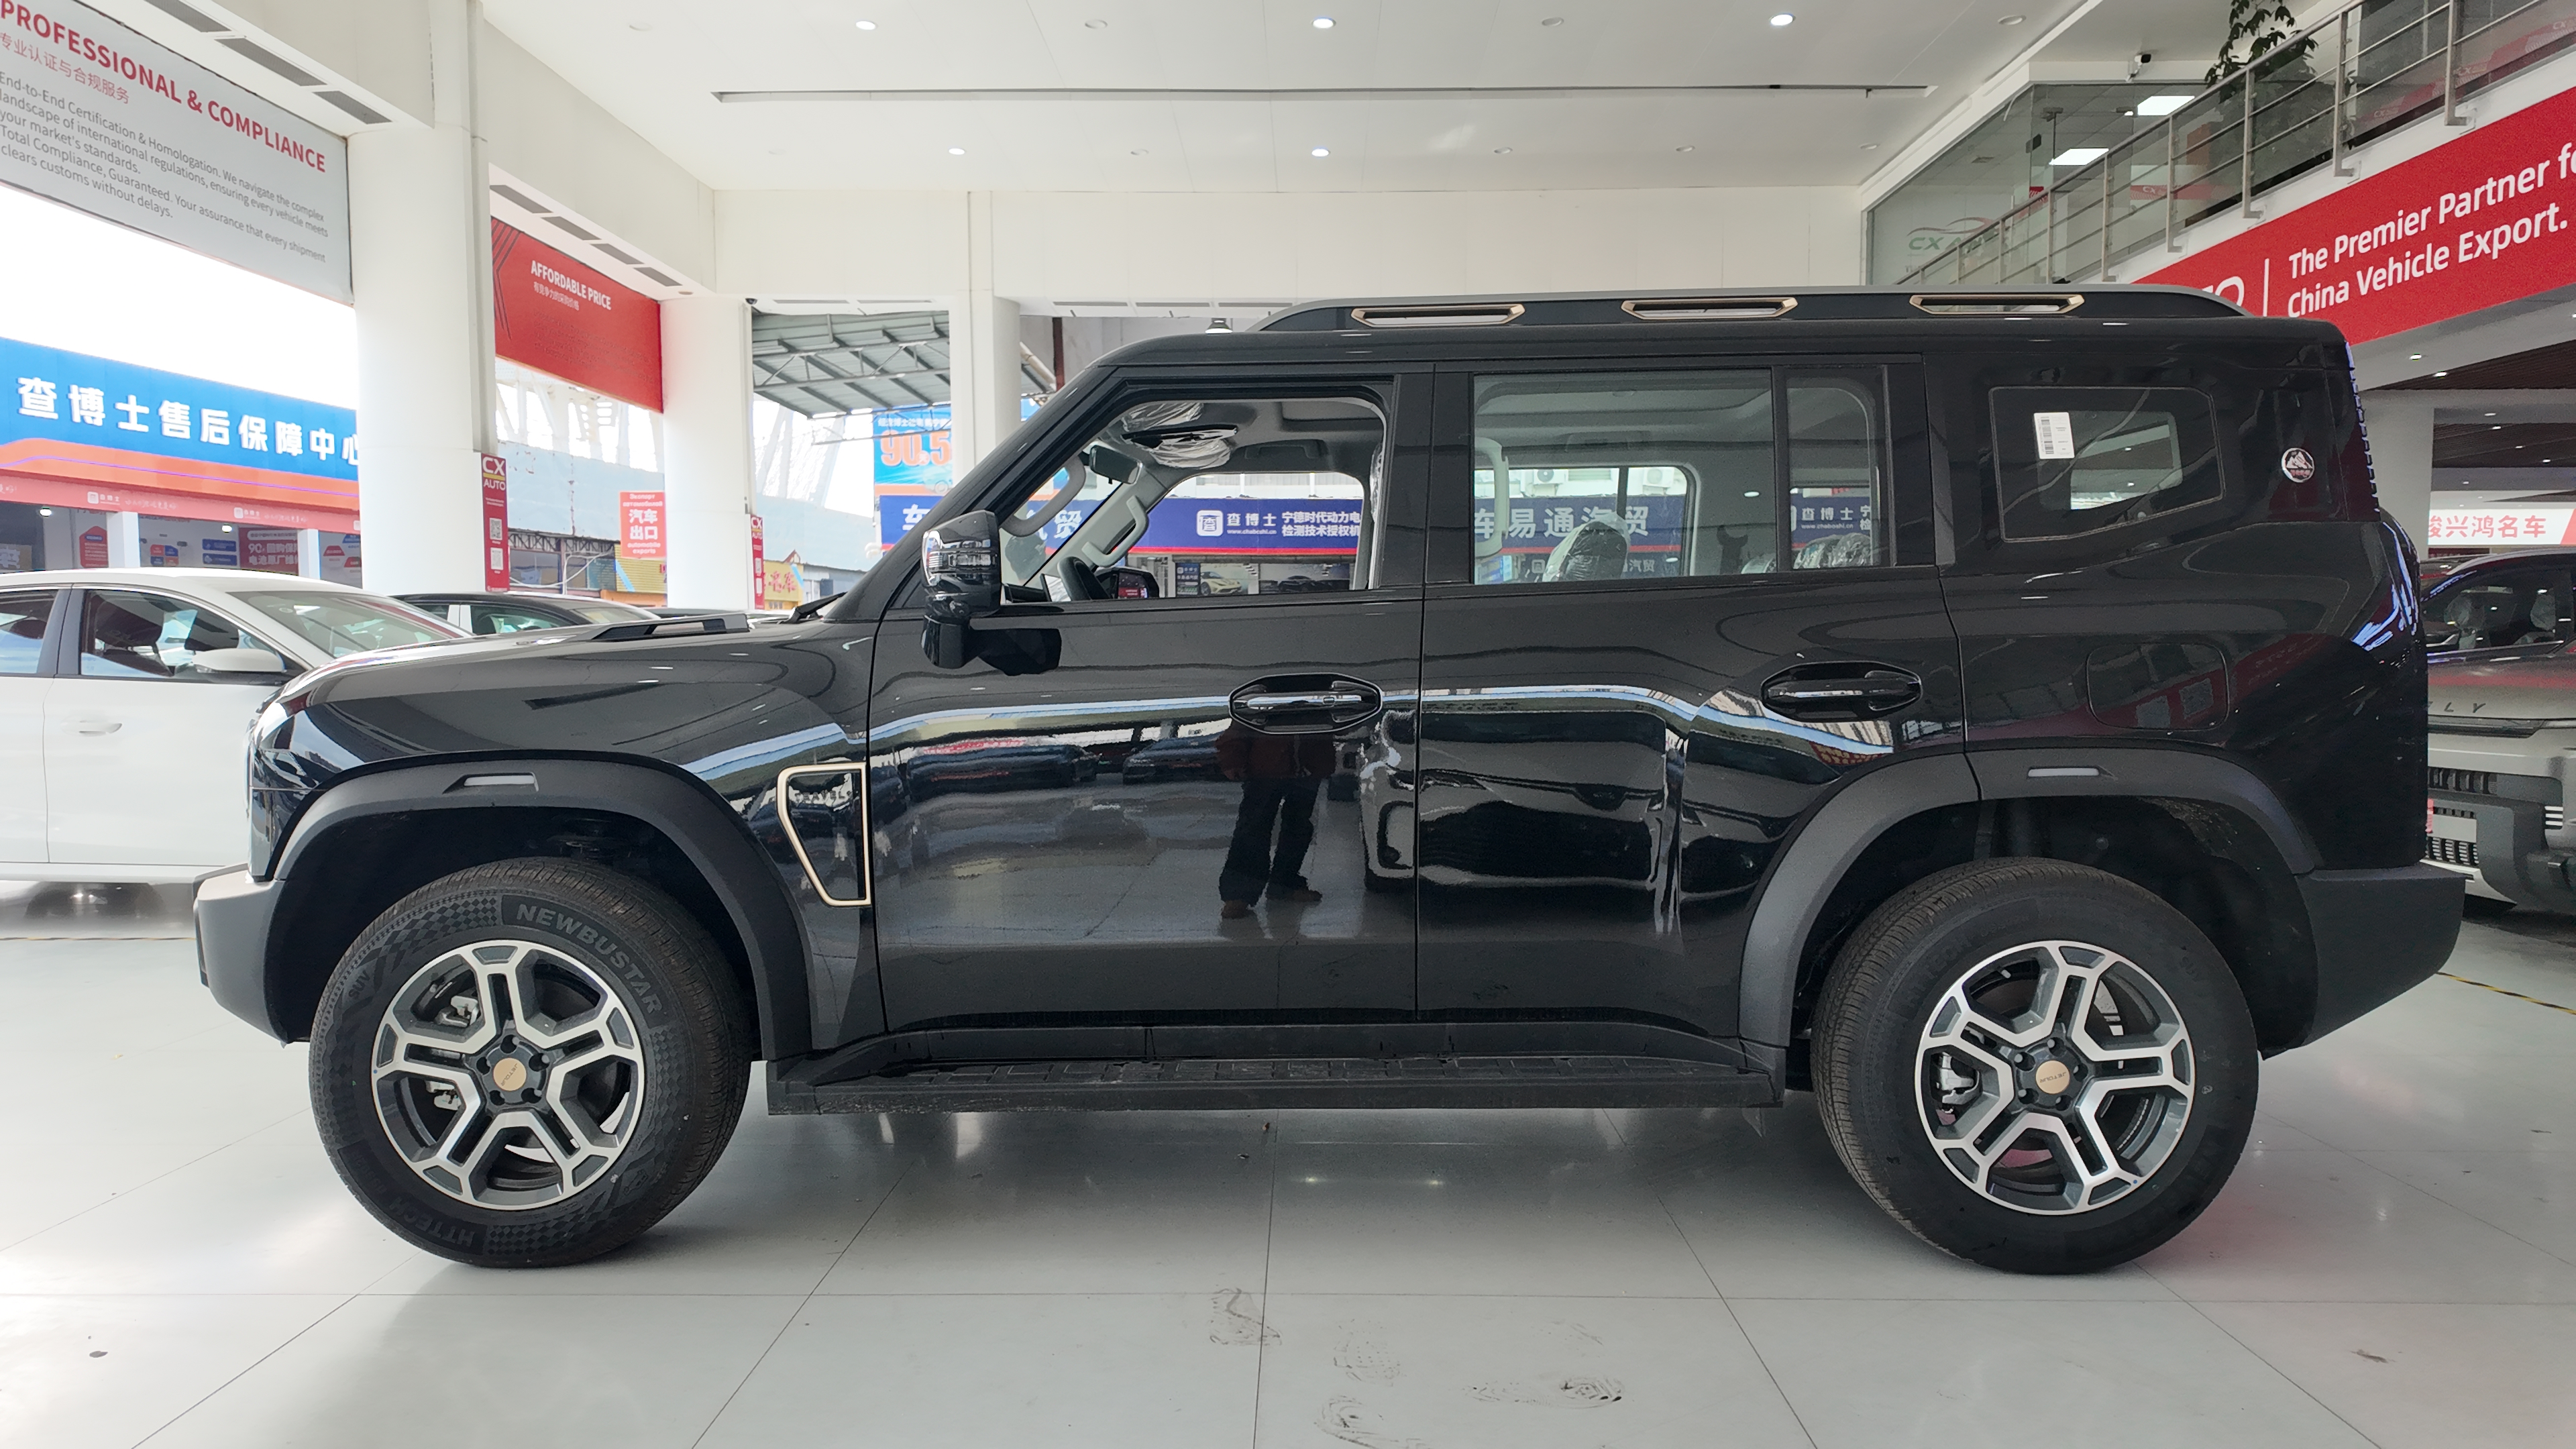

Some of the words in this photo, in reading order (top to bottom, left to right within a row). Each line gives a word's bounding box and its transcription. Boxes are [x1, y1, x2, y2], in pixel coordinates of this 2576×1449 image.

[0, 32, 129, 105] 专业认证与合规服务
[1, 0, 182, 104] PROFESSIONAL
[187, 89, 203, 113] &
[208, 101, 325, 172] COMPLIANCE
[0, 109, 26, 127] your
[30, 121, 81, 150] market's
[83, 143, 142, 175] standards.
[0, 70, 65, 109] End-to-End
[68, 101, 136, 140] Certification
[139, 132, 146, 145] &
[148, 136, 222, 178] Homologation.
[222, 169, 237, 185] We
[239, 179, 274, 201] navigate
[276, 194, 290, 207] the
[291, 203, 324, 222] complex
[0, 88, 60, 125] landscape
[62, 117, 74, 129] of
[76, 121, 148, 162] international
[150, 155, 209, 189] regulations,
[210, 180, 250, 207] ensuring
[250, 197, 274, 217] every
[275, 209, 303, 227] vehicle
[305, 221, 329, 238] meets
[1, 144, 38, 166] clears
[40, 159, 89, 186] customs
[91, 179, 136, 204] without
[137, 195, 174, 219] delays.
[1, 123, 30, 147] Total
[33, 137, 107, 178] Compliance,
[108, 168, 173, 203] Guaranteed.
[174, 193, 197, 213] Your
[199, 205, 244, 231] assurance
[246, 223, 264, 239] that
[265, 233, 288, 250] every
[289, 240, 326, 264] shipment
[1908, 236, 1944, 251] CX
[2288, 244, 2328, 279] The
[2334, 206, 2432, 264] Premier
[2438, 160, 2551, 224] Partner
[531, 260, 587, 299] AFFORDABLE
[588, 286, 612, 311] PRICE
[2287, 280, 2349, 319] China
[2356, 244, 2451, 297] Vehicle
[2457, 202, 2569, 264] Export.
[17, 376, 358, 466] 查博士售后保障中心
[482, 456, 505, 476] CX
[483, 478, 506, 491] AUTO
[629, 508, 658, 524] 汽车
[629, 525, 658, 541] 出口
[751, 517, 763, 529] CX
[1226, 513, 1277, 527] 查博士
[1801, 507, 1854, 521] 查博士
[348, 970, 370, 998] SUV
[516, 904, 663, 1014] NEWBUSTAR
[500, 1063, 518, 1086] JETOUR
[2039, 1072, 2066, 1083] JETOUR
